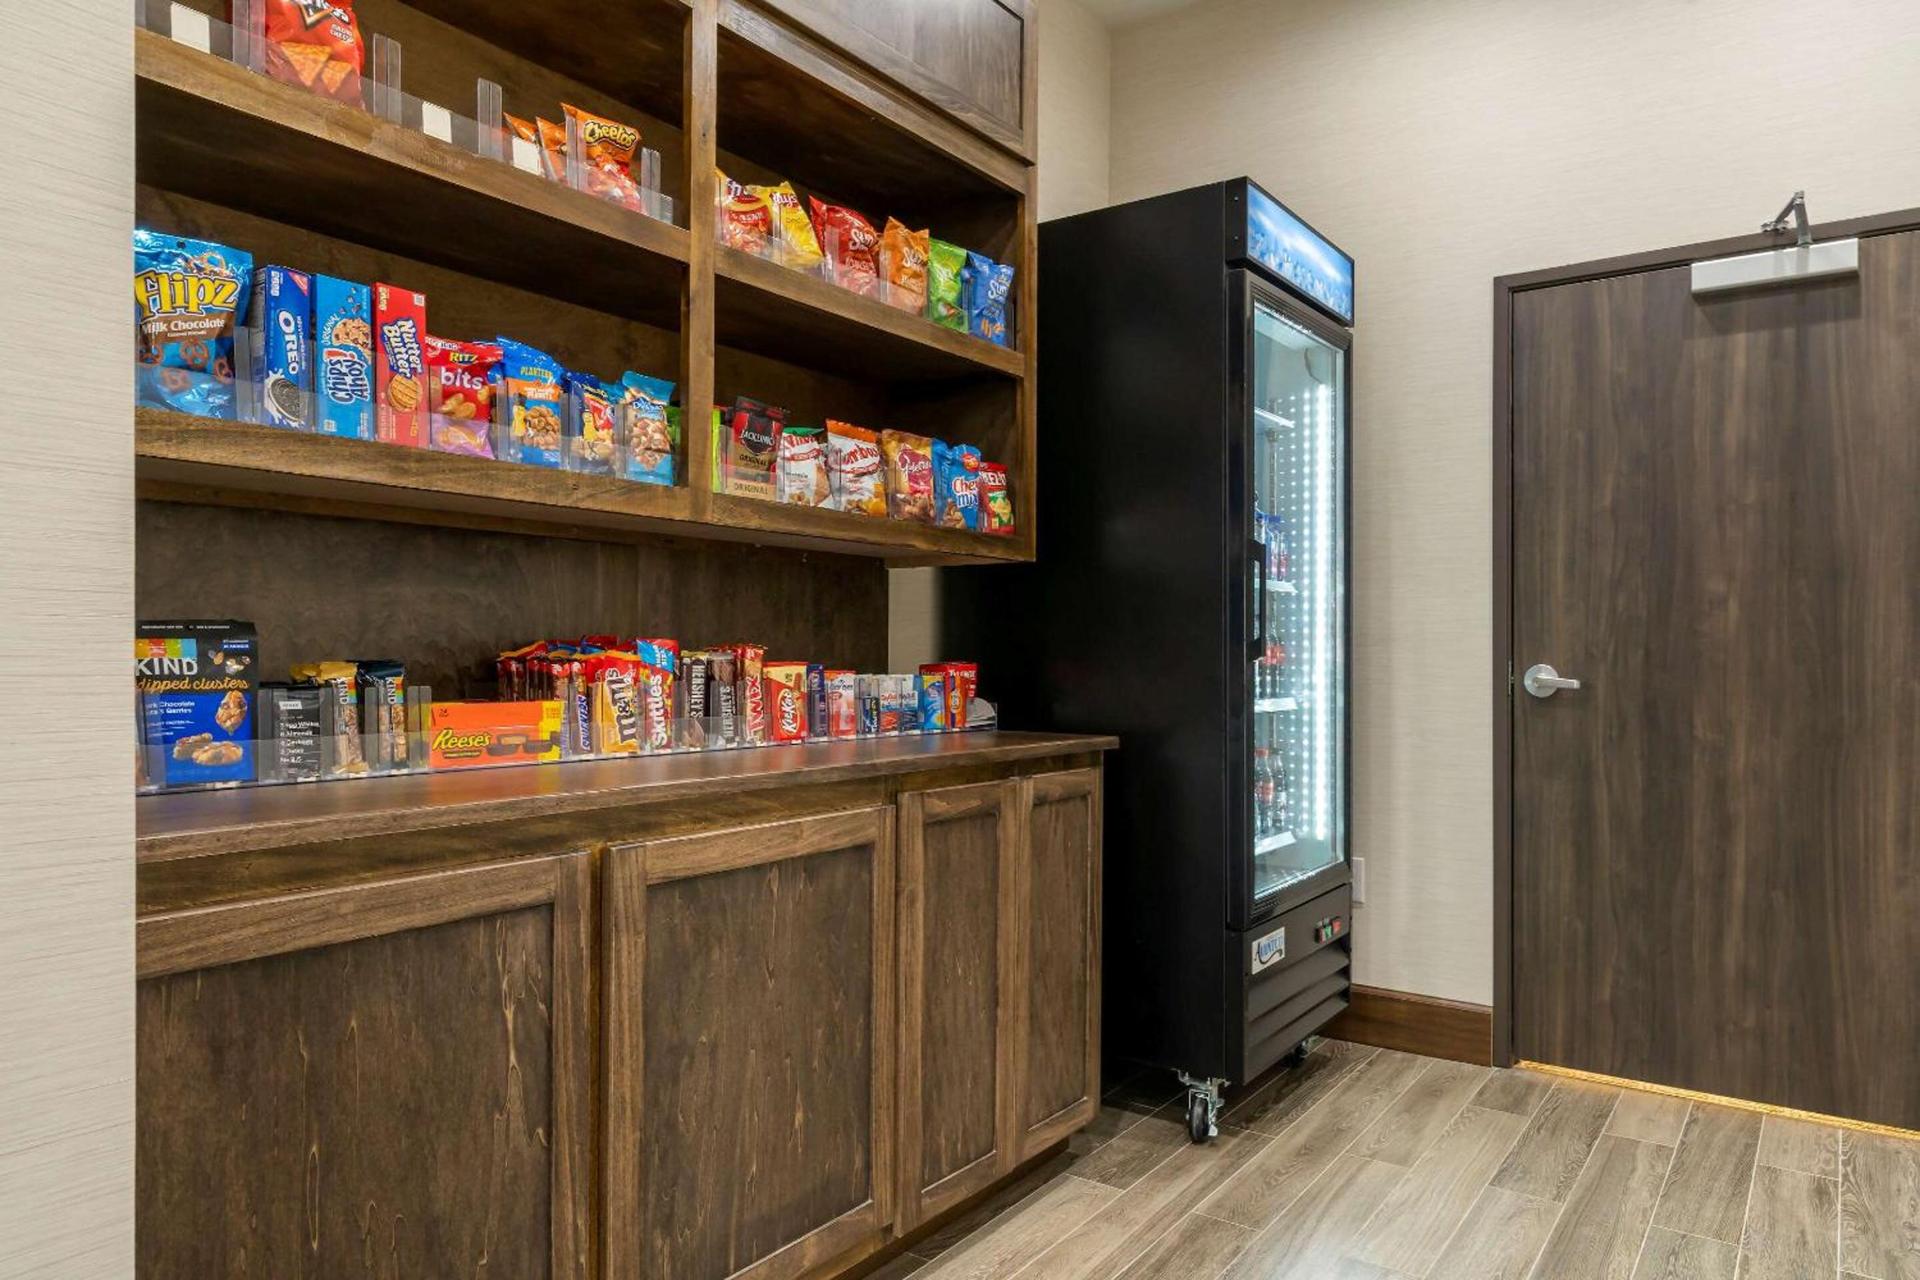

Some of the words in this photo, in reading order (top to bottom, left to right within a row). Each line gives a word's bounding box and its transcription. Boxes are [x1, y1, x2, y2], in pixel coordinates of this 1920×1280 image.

[584, 121, 636, 147] Cheetos
[135, 269, 239, 321] Flipz
[171, 319, 225, 331] Chocolate
[278, 310, 299, 374] OREO
[383, 325, 412, 379] Butter
[397, 319, 423, 374] Nutter
[449, 351, 478, 364] RITZ
[327, 357, 354, 405] Chips
[441, 366, 485, 390] bits
[952, 476, 980, 495] Che
[136, 657, 198, 676] KIND
[136, 677, 191, 695] dipped
[193, 676, 249, 690] clusters
[337, 677, 348, 705] KIND
[386, 677, 396, 705] KIND
[689, 664, 706, 720] HERSHEY'S
[646, 674, 668, 747] Skittles
[432, 728, 490, 751] Reese's
